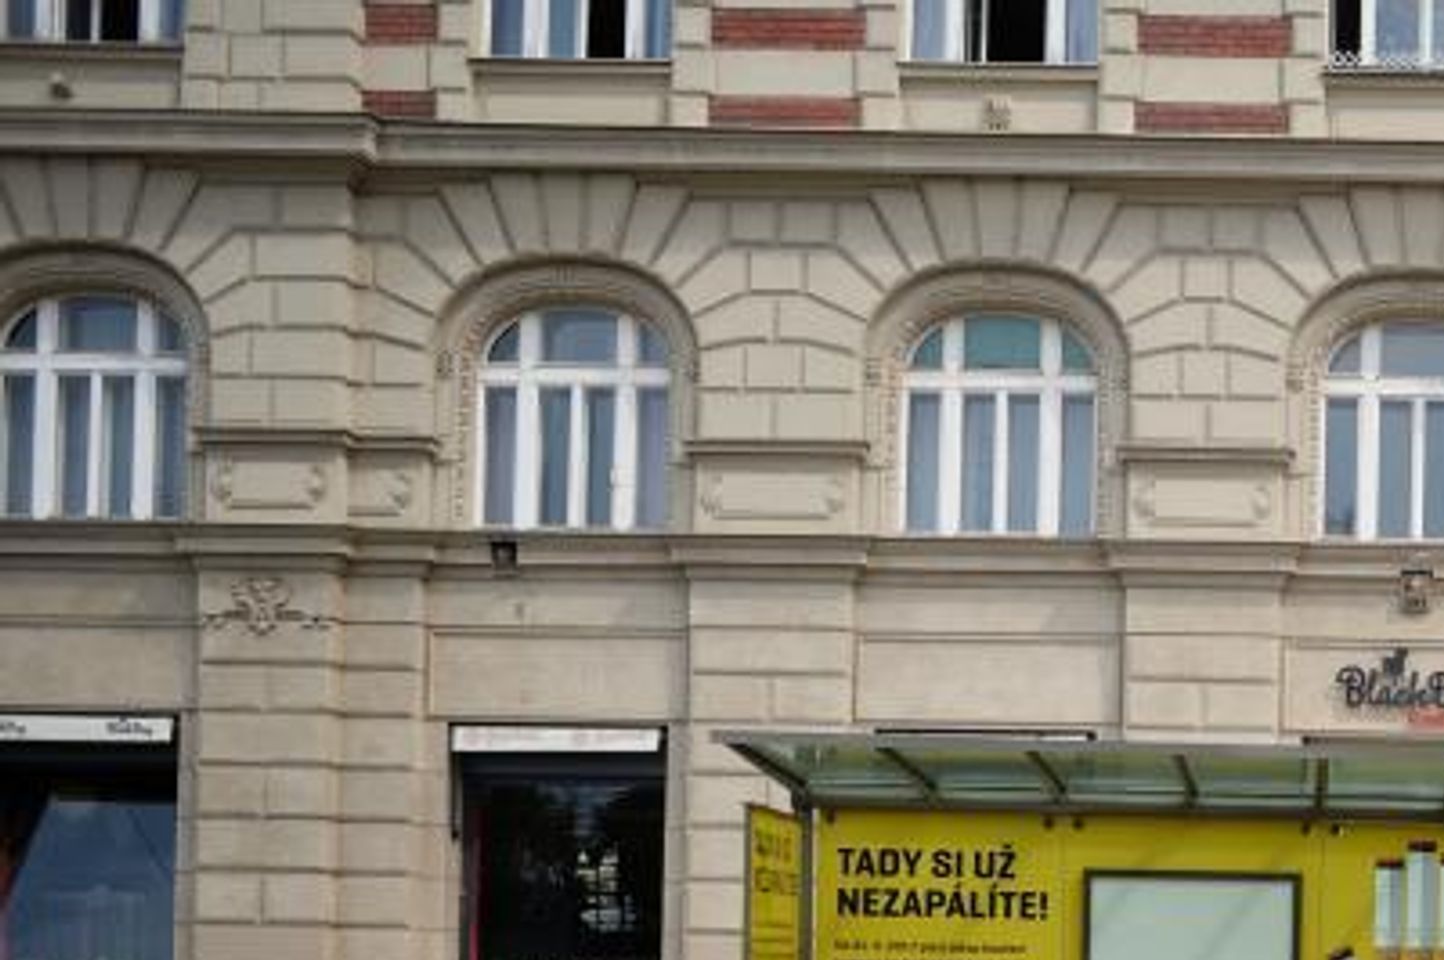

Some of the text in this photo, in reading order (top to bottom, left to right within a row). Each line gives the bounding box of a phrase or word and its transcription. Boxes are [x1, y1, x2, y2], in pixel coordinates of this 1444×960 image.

[1336, 666, 1427, 708] Black
[837, 844, 1016, 880] TADY SI UŽ
[836, 883, 1049, 920] NEZAPÁLÍTE!
